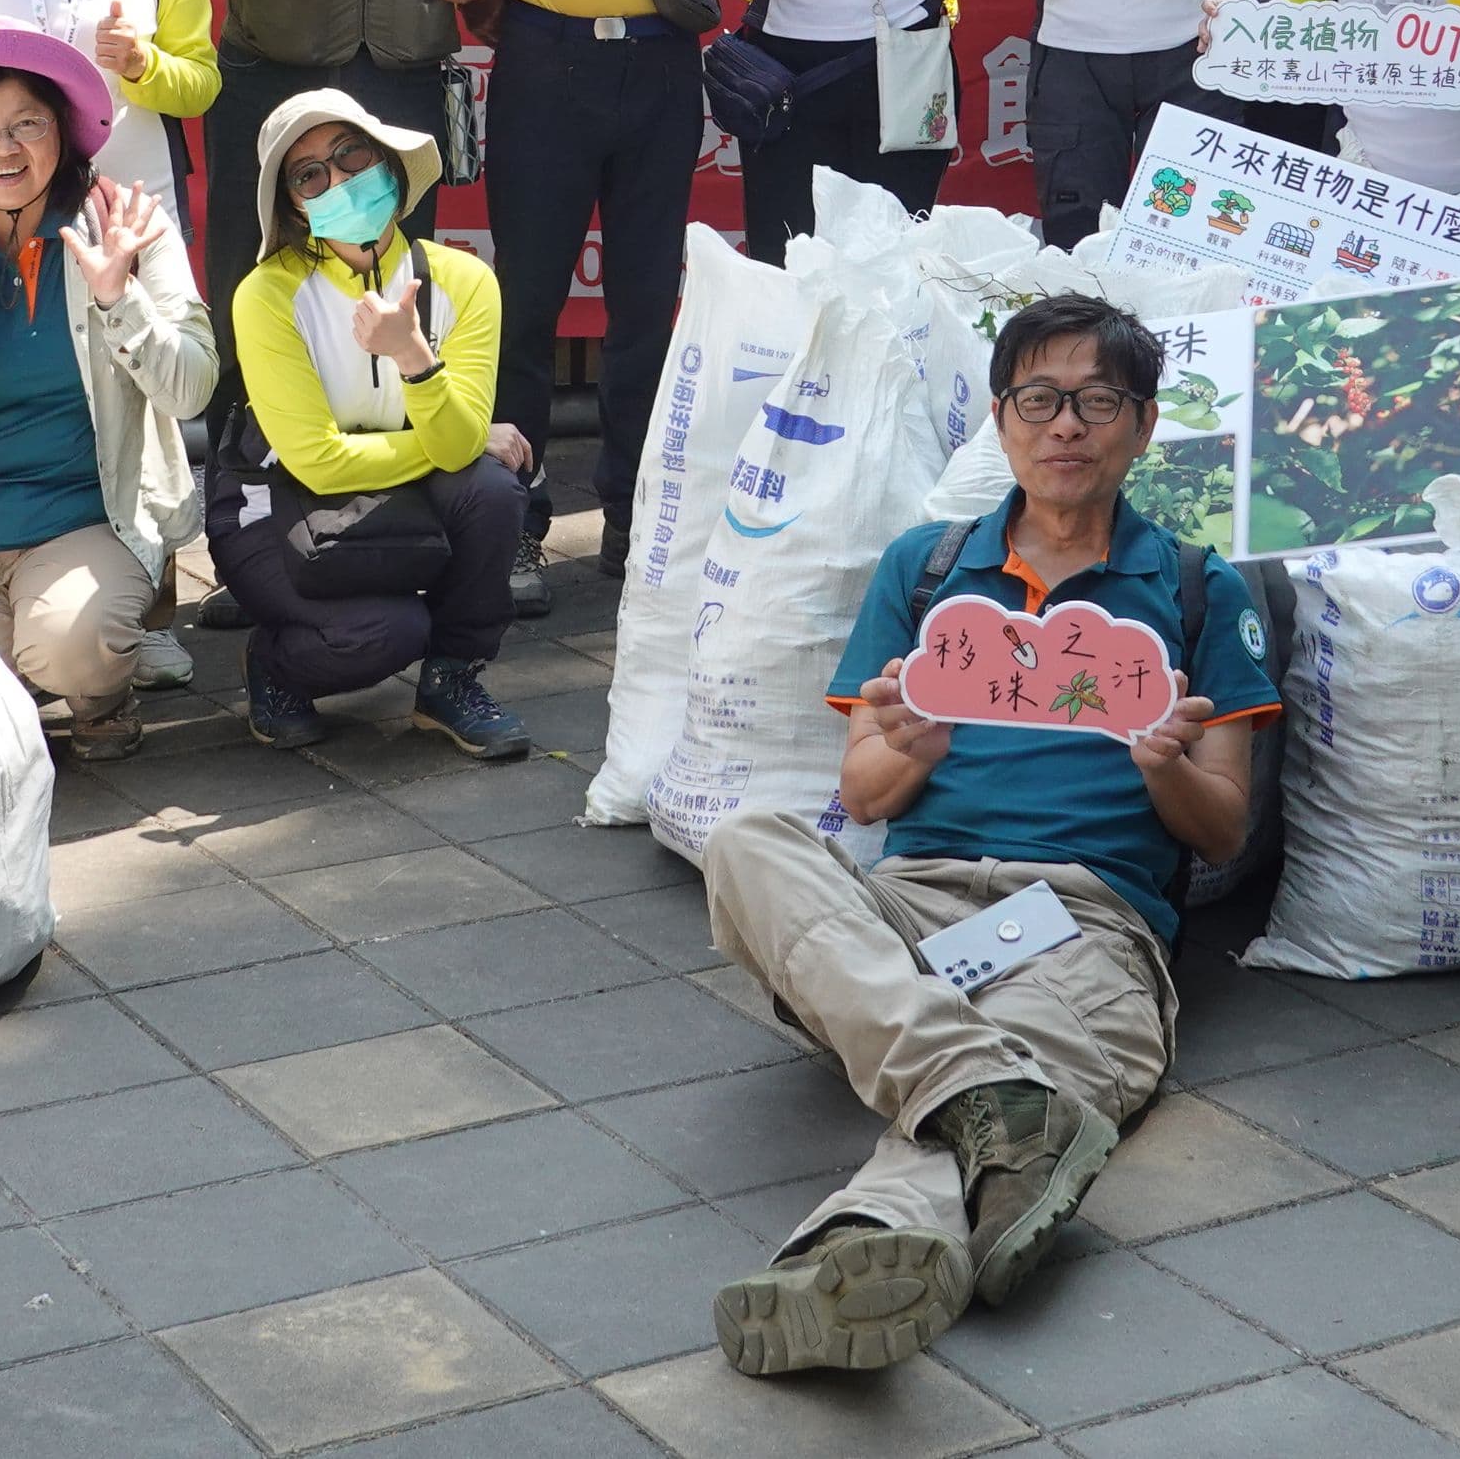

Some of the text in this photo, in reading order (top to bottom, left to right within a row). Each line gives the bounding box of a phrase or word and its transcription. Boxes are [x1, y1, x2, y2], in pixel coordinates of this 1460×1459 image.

[1222, 13, 1379, 54] 入侵植物
[1256, 249, 1308, 275] 科學研究
[645, 373, 697, 589] 海洋飼料 虱目魚專用
